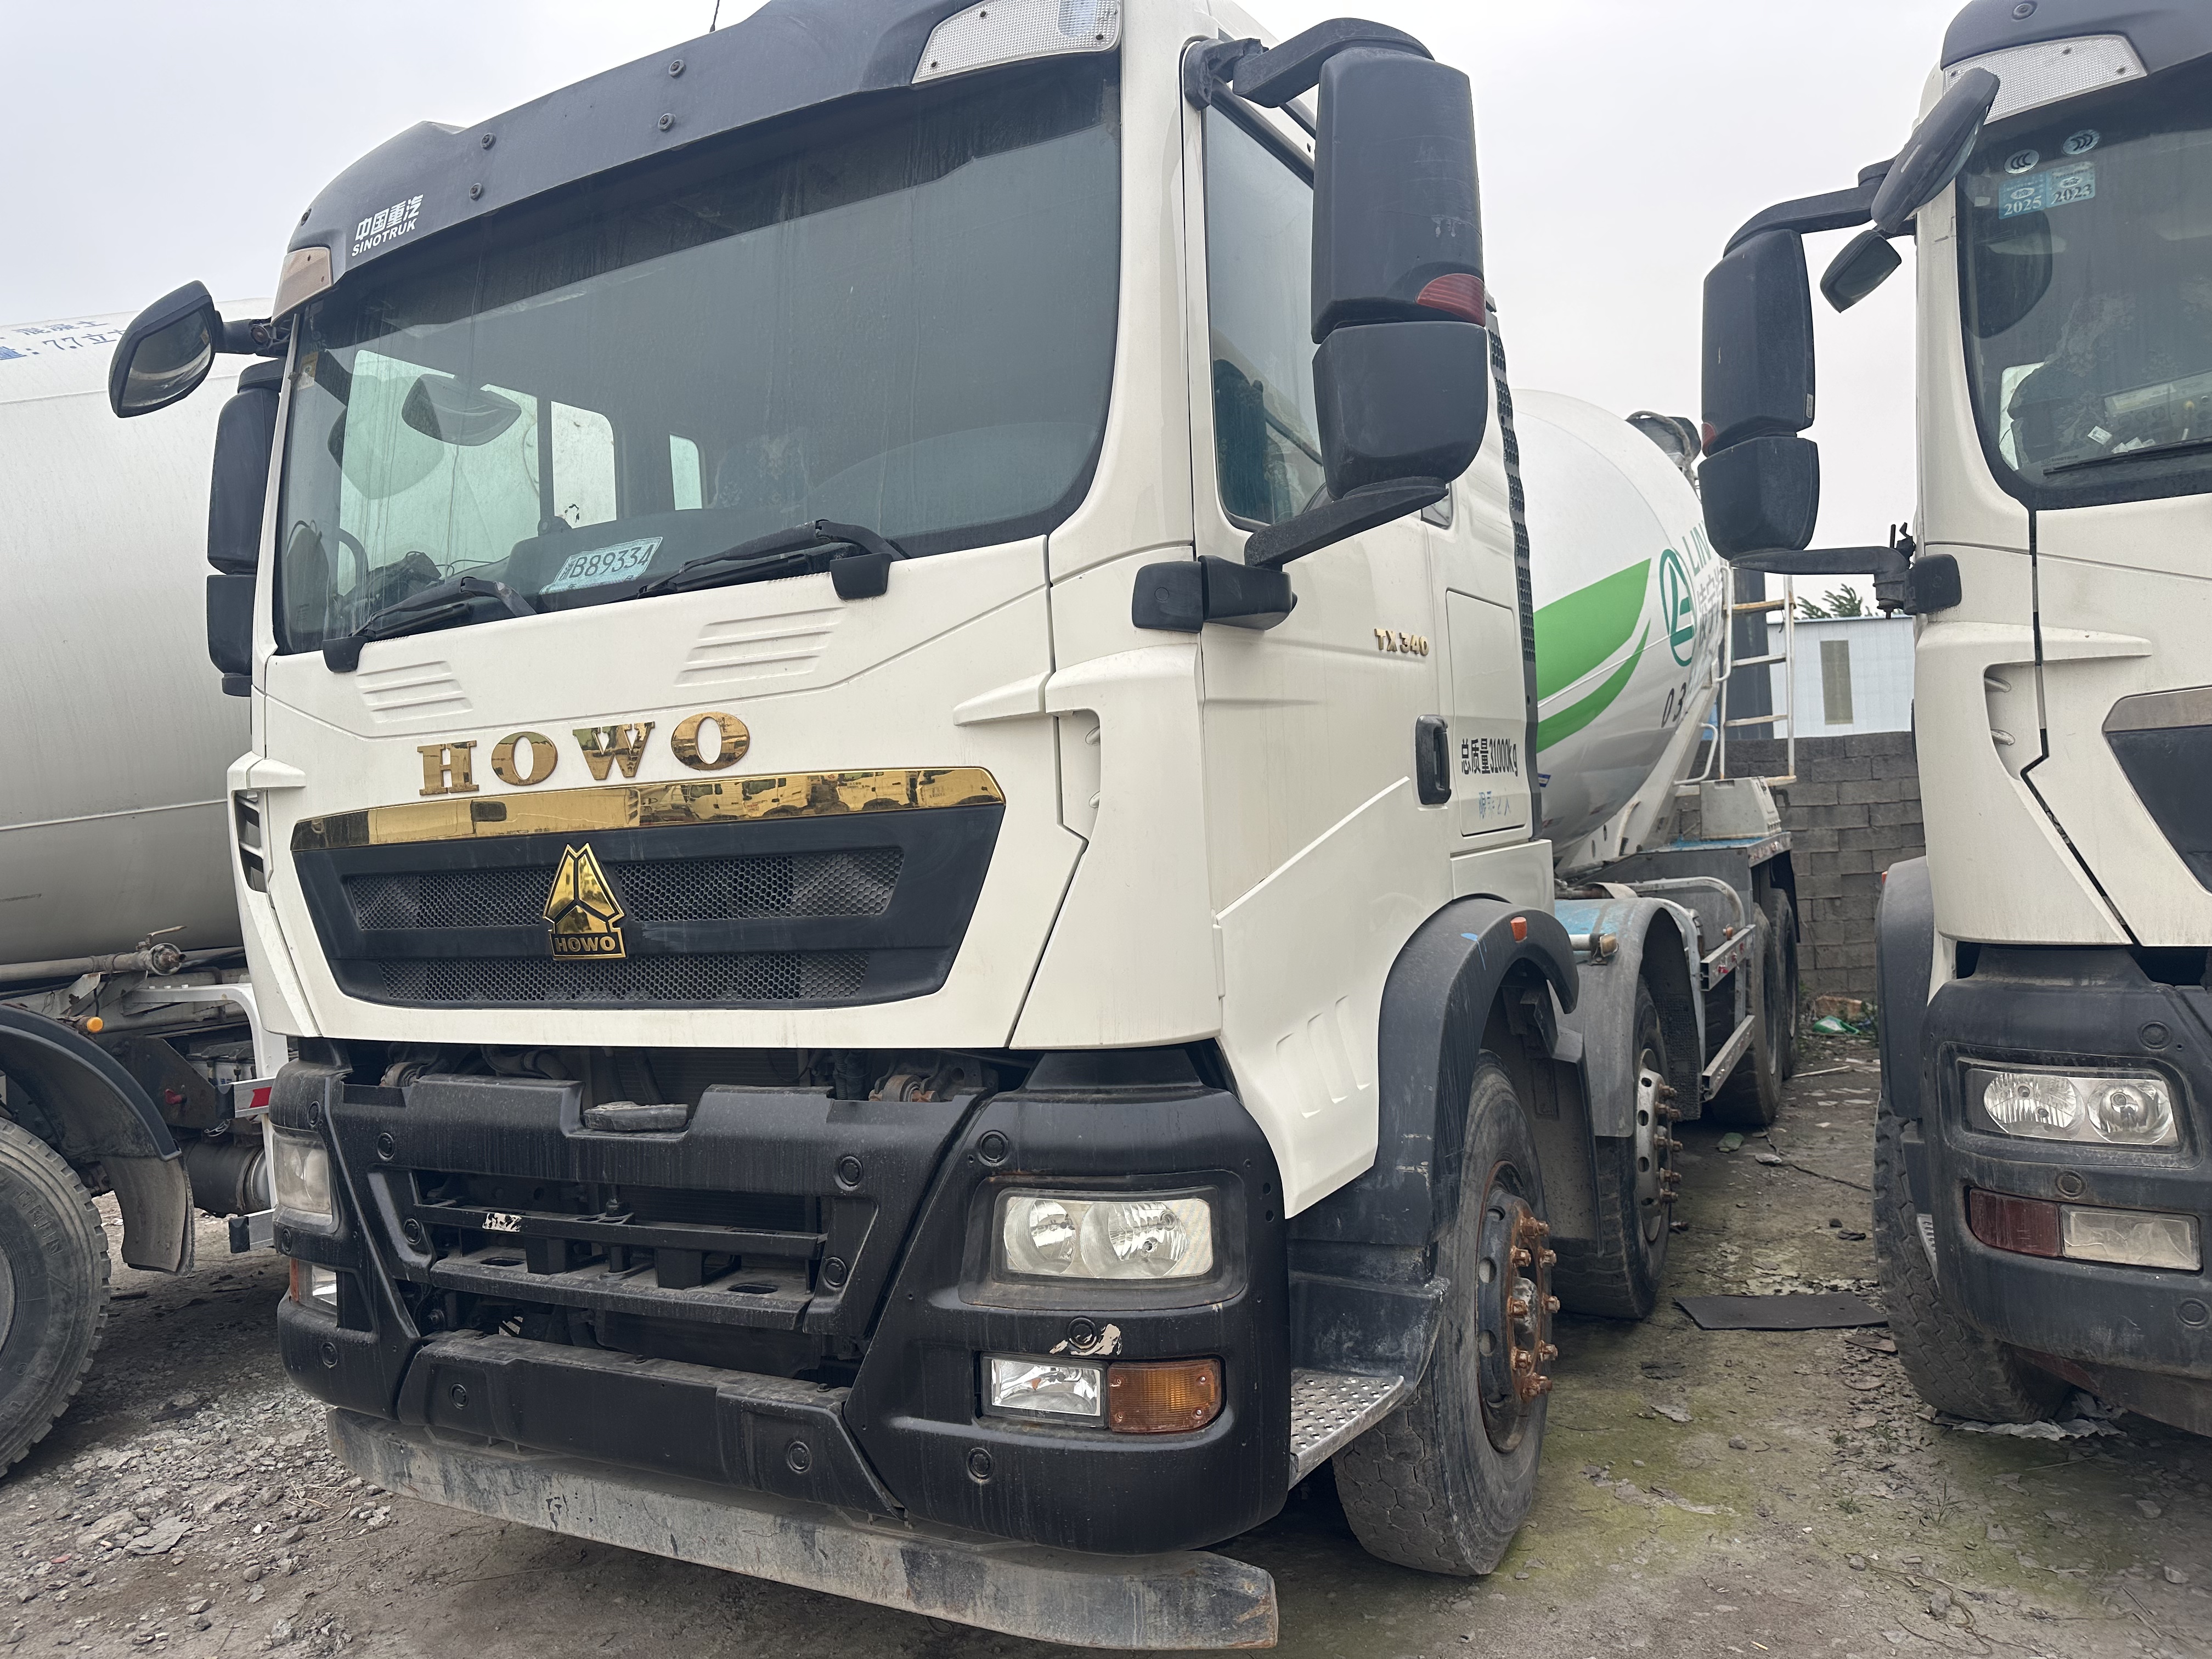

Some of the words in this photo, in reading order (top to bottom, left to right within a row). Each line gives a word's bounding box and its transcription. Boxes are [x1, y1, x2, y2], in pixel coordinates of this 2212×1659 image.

[2004, 195, 2042, 216] 2025
[2051, 184, 2092, 205] 2023
[355, 194, 424, 241] 中国重汽
[352, 218, 417, 257] SINOTRUK
[1682, 520, 1712, 577] LIN
[417, 712, 750, 795] HOWO
[554, 936, 616, 952] HOWO
